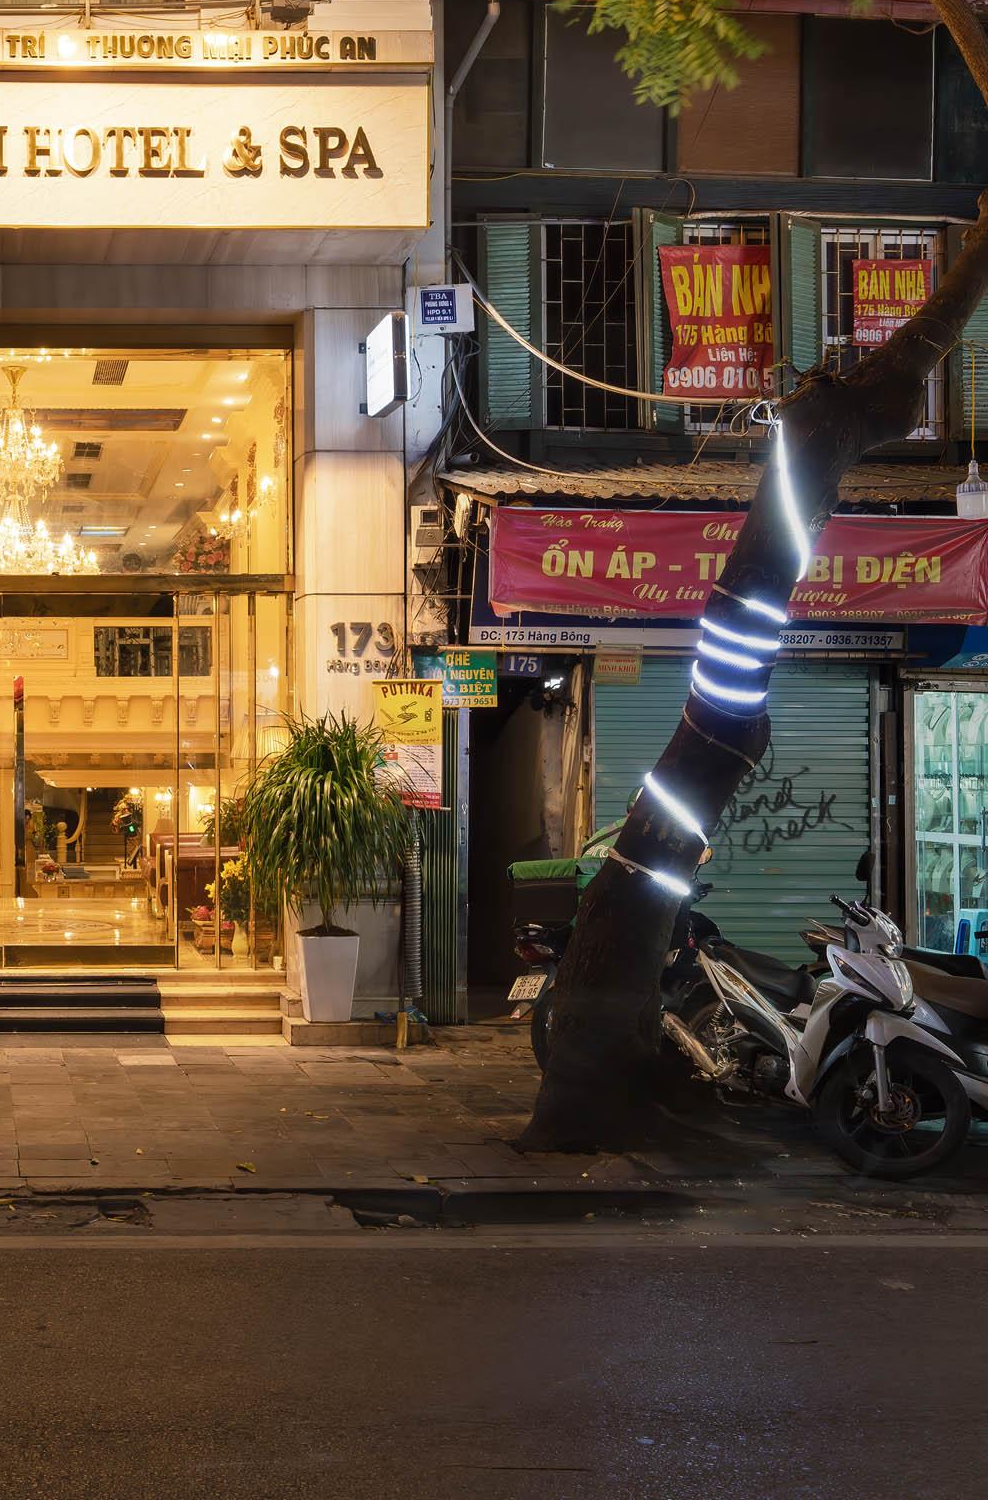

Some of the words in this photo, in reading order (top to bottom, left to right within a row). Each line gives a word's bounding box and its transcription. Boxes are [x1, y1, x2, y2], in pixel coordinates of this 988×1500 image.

[5, 30, 46, 59] TRÍ
[86, 34, 192, 59] THƯƠNG
[263, 31, 330, 60] PHÚC
[339, 36, 377, 60] AN
[22, 125, 206, 178] HOTEL
[222, 125, 263, 178] &
[279, 125, 384, 179] SPA
[671, 252, 723, 316] BÁN
[732, 264, 772, 316] NH
[858, 263, 891, 300] BÁN
[894, 263, 926, 300] NHÀ
[428, 292, 447, 300] TBA
[857, 304, 875, 316] 175
[877, 303, 903, 318] Hàng
[675, 324, 698, 346] 175
[701, 324, 748, 345] Hàng
[753, 322, 773, 344] Bô
[855, 328, 883, 342] 0906
[707, 347, 736, 362] Liên
[739, 347, 757, 365] Hệ:
[667, 366, 717, 389] 0906
[722, 366, 759, 389] 010
[702, 522, 739, 542] Chu
[540, 538, 594, 579] ỔN
[606, 544, 656, 580] ÁP
[807, 555, 844, 589] BỊ
[855, 551, 941, 589] ĐIỆN
[633, 582, 670, 602] Uy
[675, 584, 706, 601] tín
[603, 605, 637, 619] Bông
[330, 622, 396, 656] 173
[480, 630, 501, 641] ĐC:
[505, 631, 525, 641] 175
[528, 630, 557, 643] Hàng
[560, 630, 591, 644] Bông
[778, 634, 816, 645] 288207
[450, 667, 495, 680] NGUYÊN
[508, 655, 538, 673] 175
[459, 681, 493, 696] BIỆT
[474, 696, 494, 706] 9651
